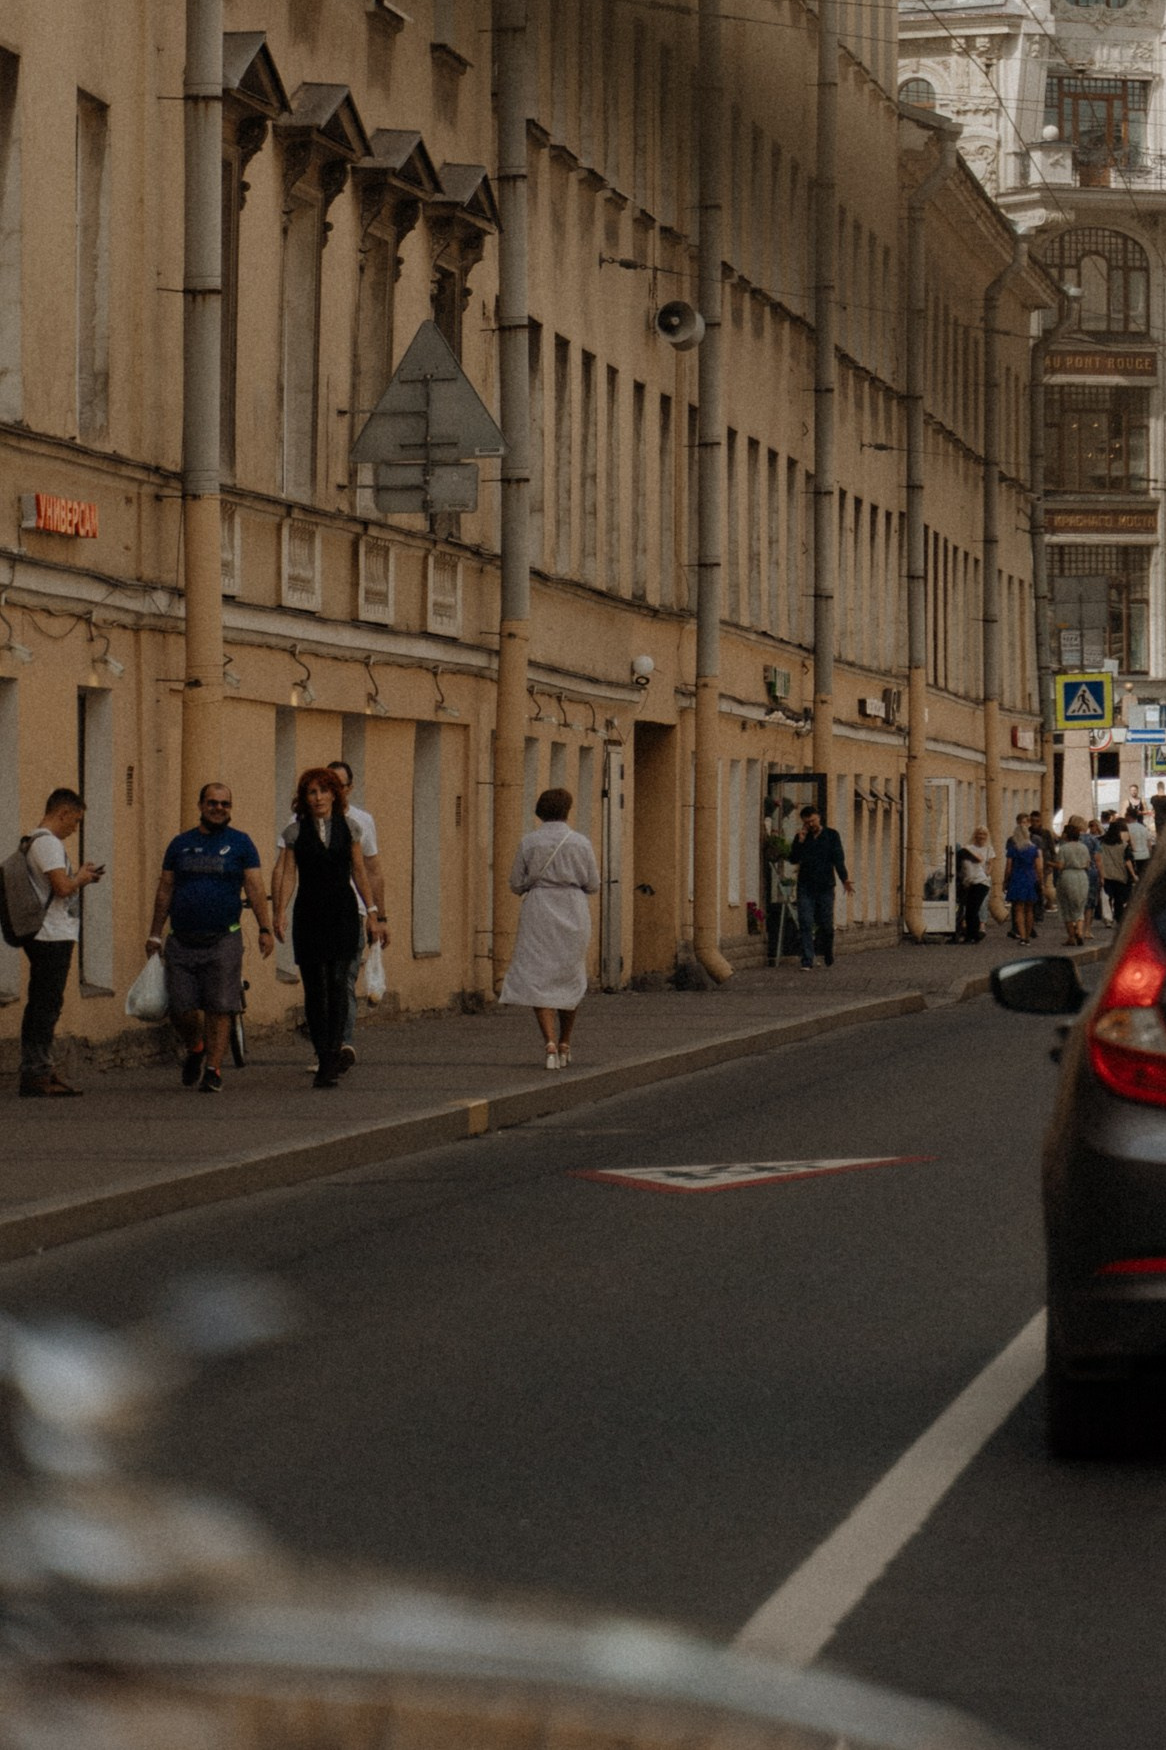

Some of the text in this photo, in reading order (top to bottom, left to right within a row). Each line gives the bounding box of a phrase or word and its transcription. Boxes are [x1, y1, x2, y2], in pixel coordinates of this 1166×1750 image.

[1067, 356, 1101, 369] PONT
[1108, 358, 1152, 370] ROUGE
[35, 493, 98, 538] УНИВЕРСАМ
